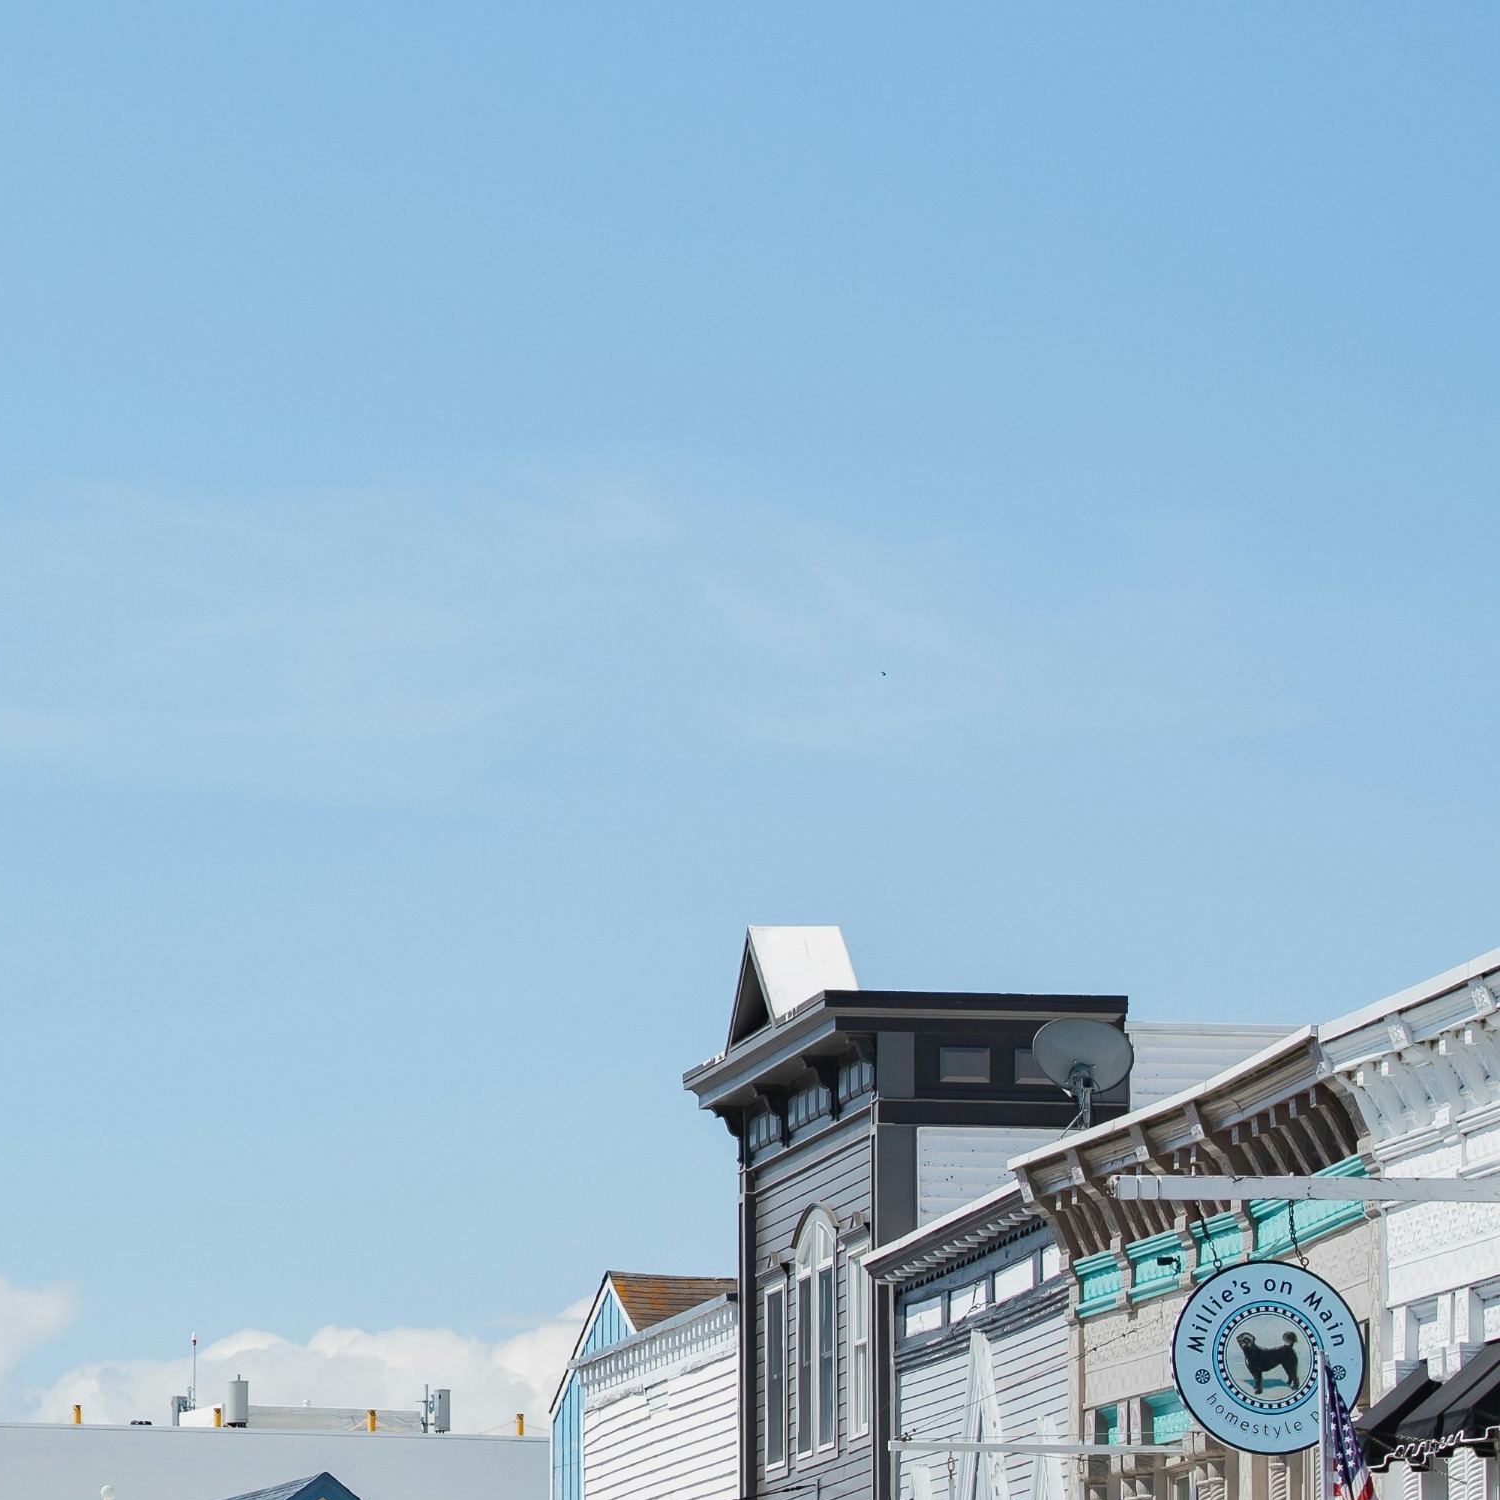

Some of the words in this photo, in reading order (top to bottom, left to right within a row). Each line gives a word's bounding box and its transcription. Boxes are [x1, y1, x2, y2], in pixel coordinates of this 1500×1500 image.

[1187, 1280, 1251, 1353] Millie's
[1264, 1278, 1292, 1295] on
[1303, 1290, 1345, 1347] Main
[1206, 1392, 1303, 1439] homestyle
